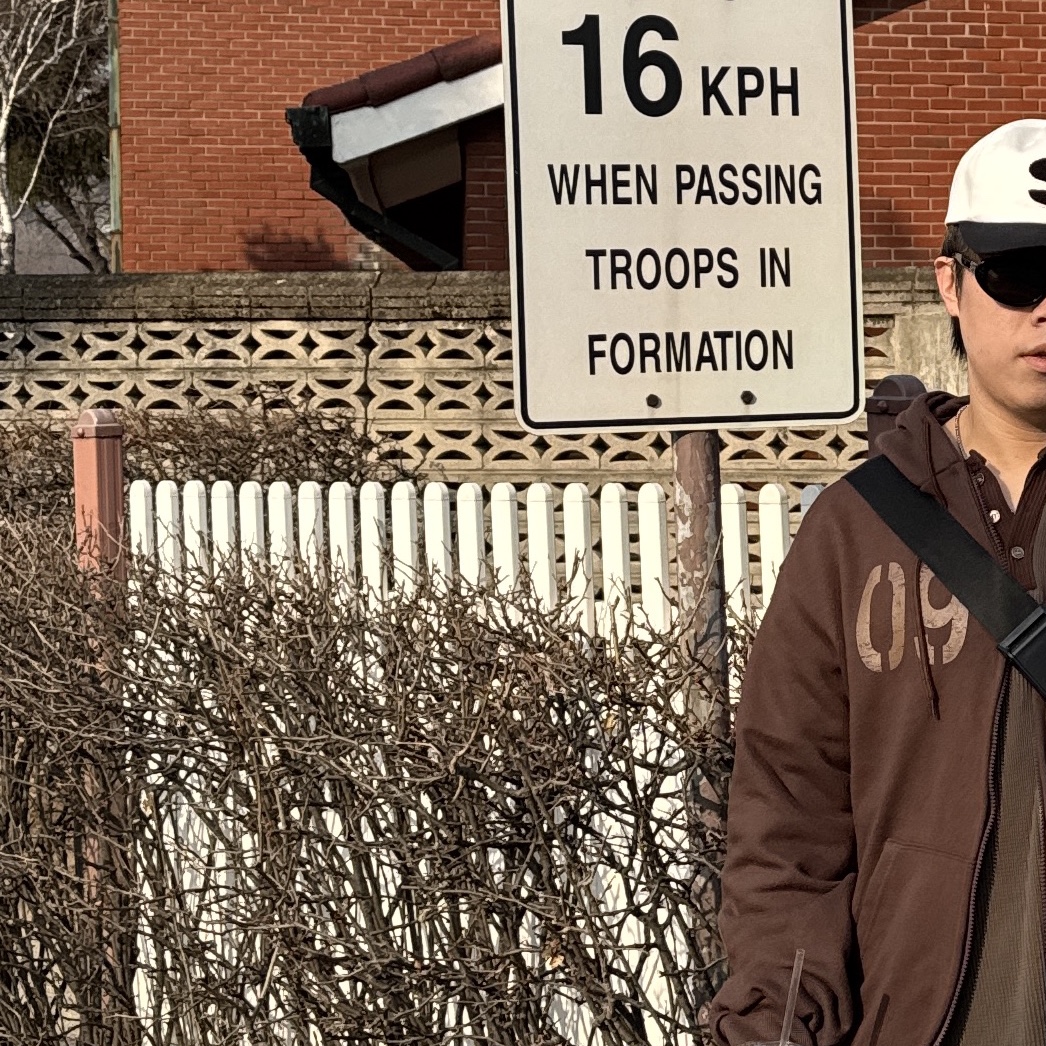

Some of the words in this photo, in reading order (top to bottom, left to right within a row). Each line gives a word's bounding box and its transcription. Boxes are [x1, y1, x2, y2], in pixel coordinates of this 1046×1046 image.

[562, 15, 682, 117] 16
[702, 66, 799, 116] KPH
[548, 164, 657, 205] WHEN
[676, 164, 821, 205] PASSING
[586, 247, 738, 290] TROOPS
[760, 248, 790, 287] IN
[588, 330, 793, 375] FORMATION
[856, 561, 969, 673] 09
